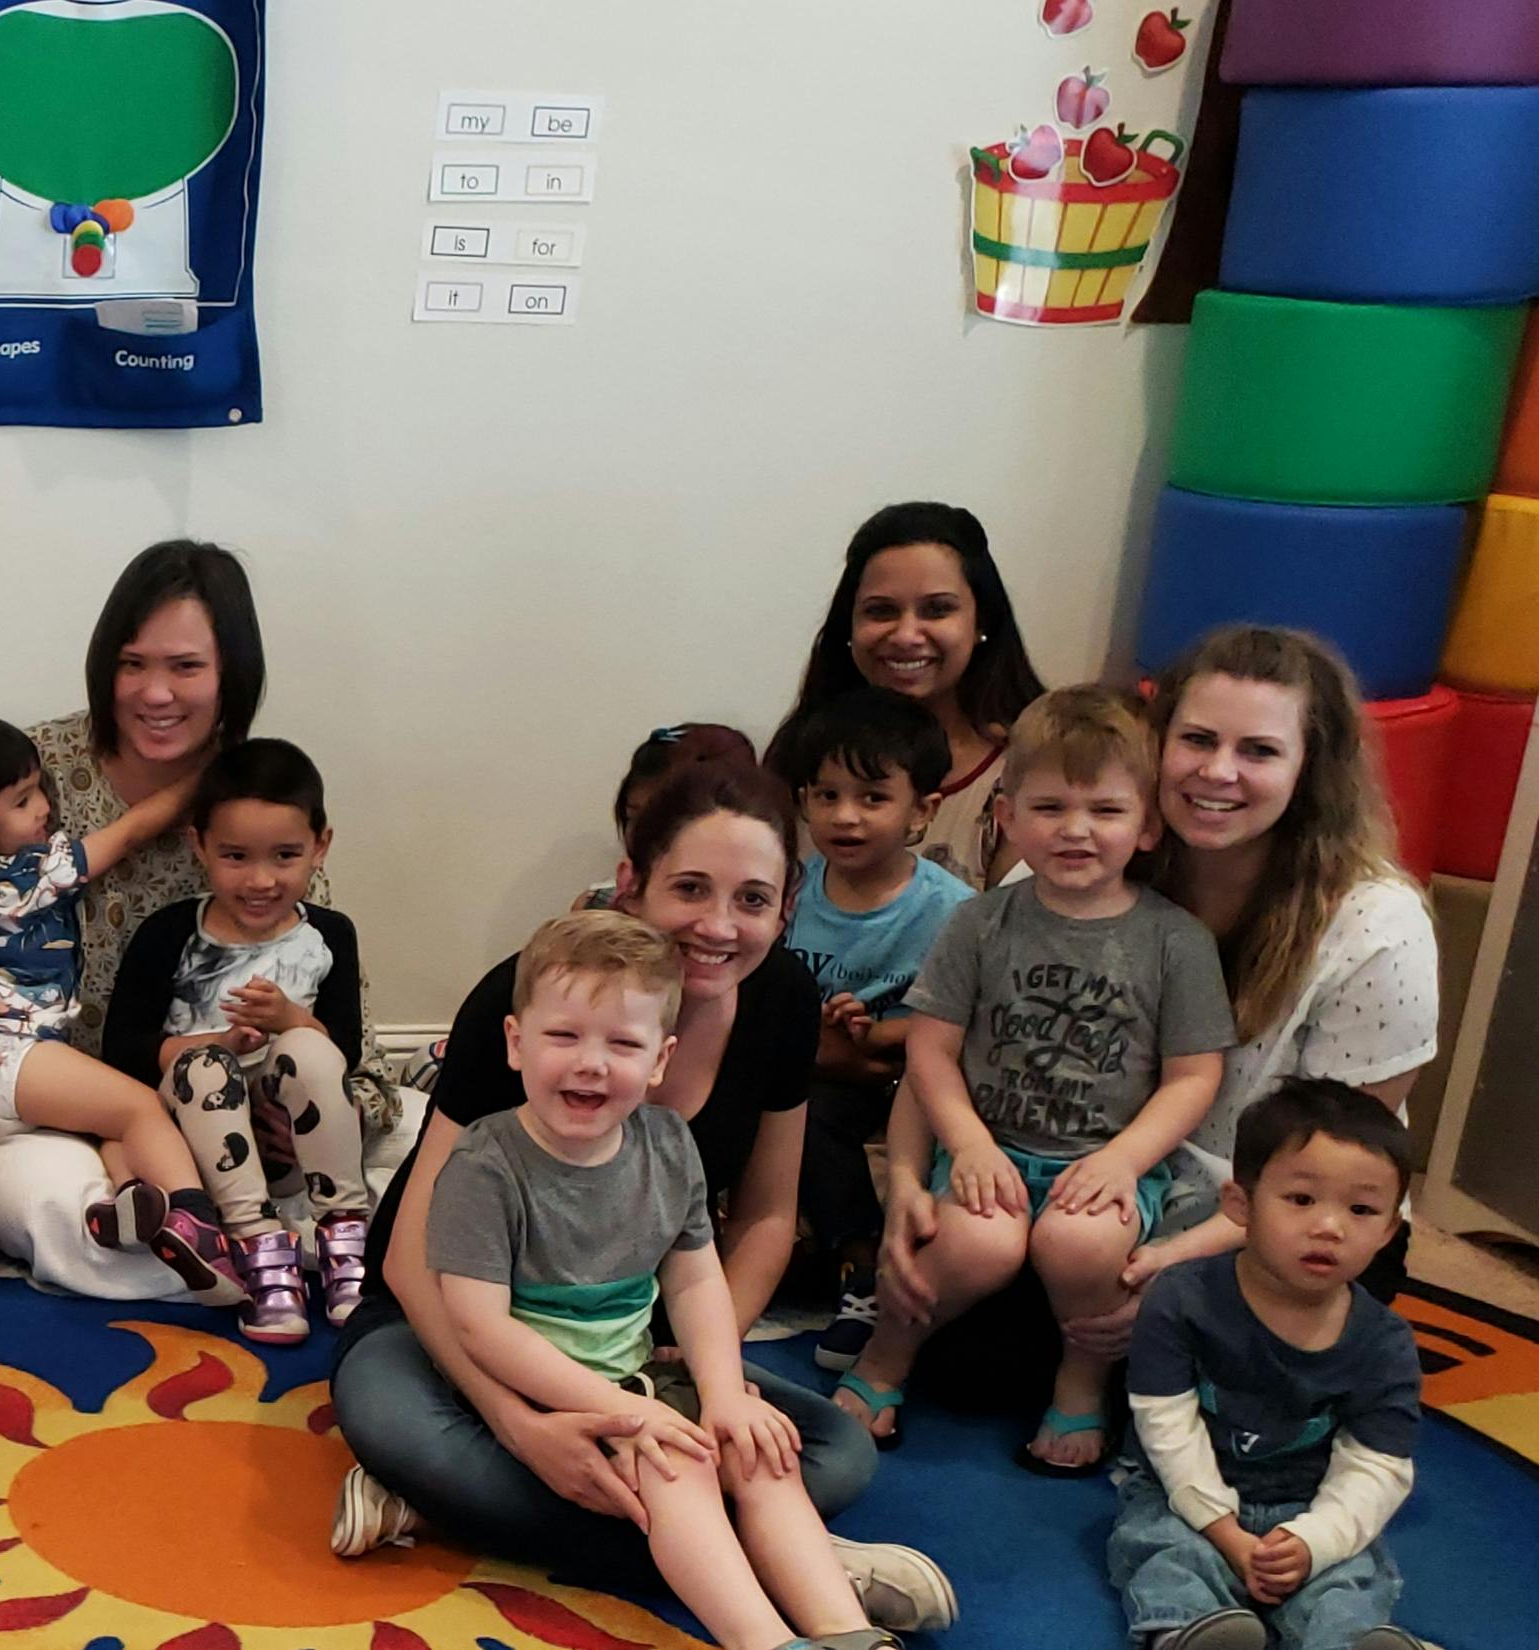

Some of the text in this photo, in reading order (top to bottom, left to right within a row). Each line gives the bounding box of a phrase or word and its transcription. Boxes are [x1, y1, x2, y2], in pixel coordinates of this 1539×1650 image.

[460, 114, 491, 134] my
[547, 115, 573, 133] be
[459, 173, 480, 190] to
[546, 173, 562, 191] in
[454, 234, 466, 252] is
[531, 237, 557, 257] for
[448, 290, 459, 307] it
[524, 295, 549, 310] on
[114, 349, 195, 371] Counting
[1012, 963, 1124, 1003] I GET MY
[1058, 1078, 1095, 1101] MY
[976, 1082, 1110, 1137] PARENTS
